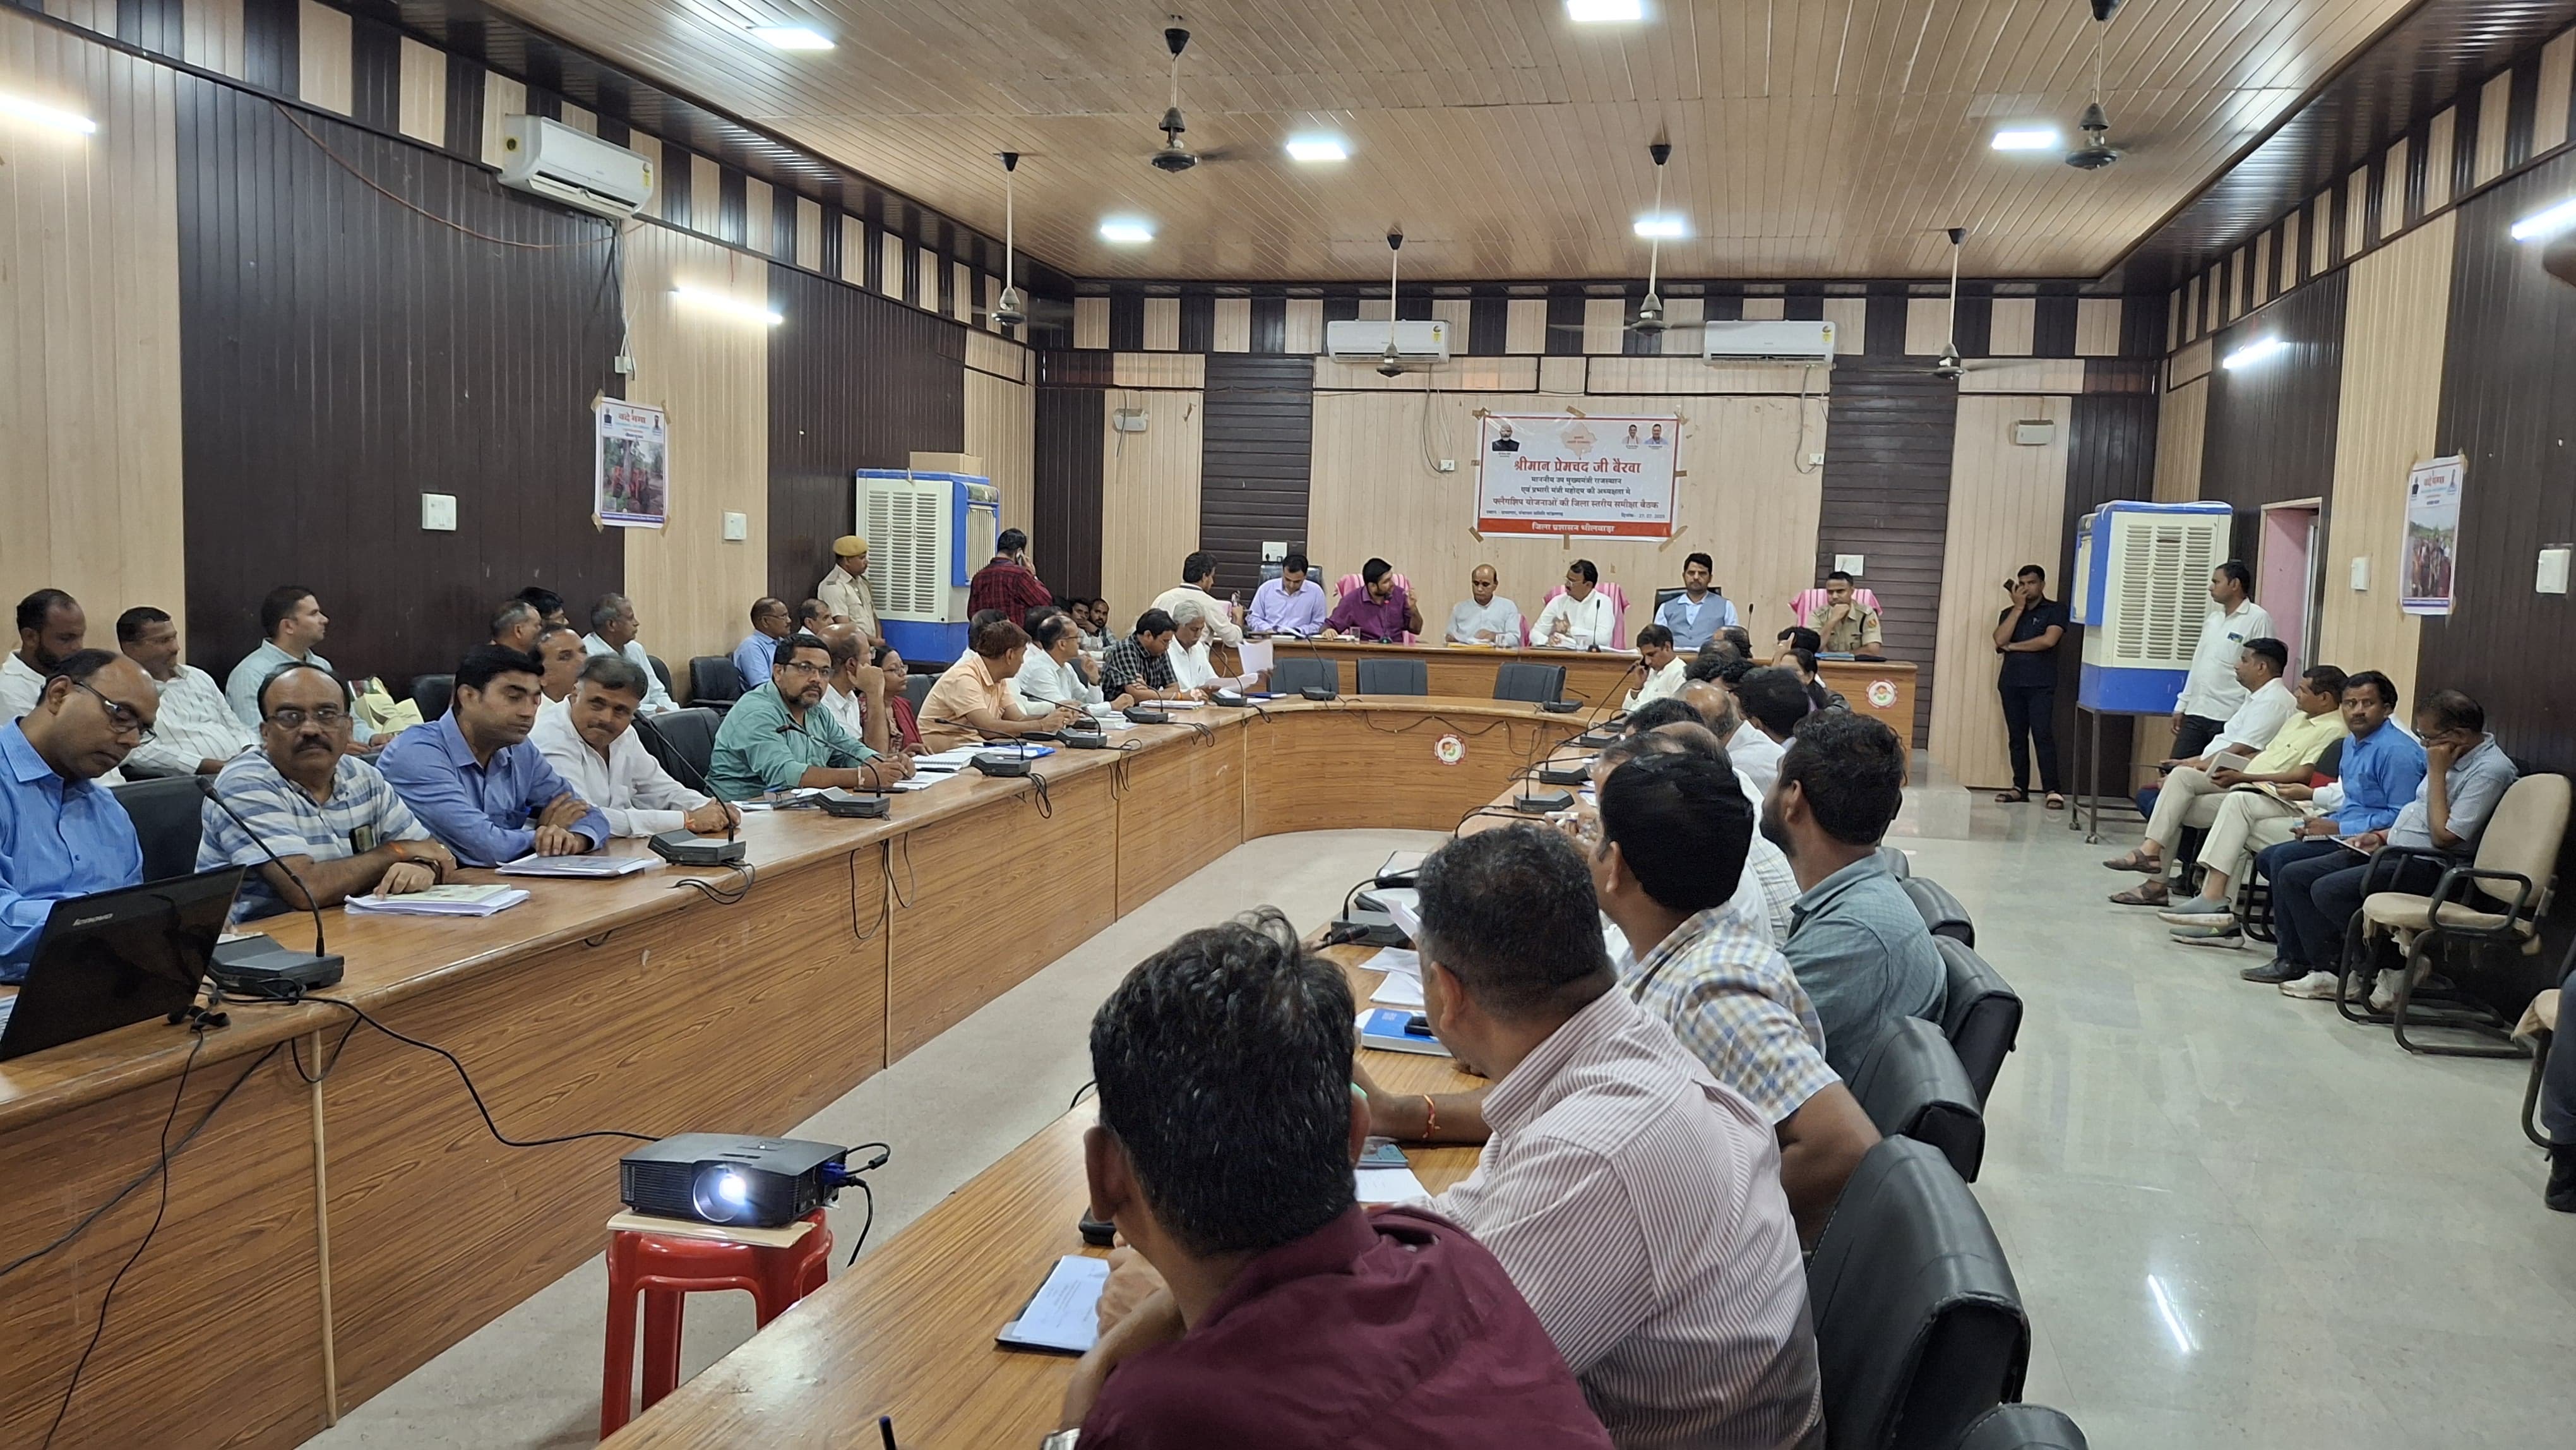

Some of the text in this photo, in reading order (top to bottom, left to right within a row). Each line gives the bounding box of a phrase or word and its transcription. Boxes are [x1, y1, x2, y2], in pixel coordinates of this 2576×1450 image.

[1514, 455, 1642, 474] श्रीमान प्रेमचंद जी बैरवा
[1531, 475, 1554, 483] माननीय
[1587, 486, 1595, 494] की
[1493, 496, 1659, 509] फ्लैगशिप योजनाओं की जिला स्तरीय समीक्षा बैठक
[1532, 520, 1615, 534] जिला प्रशासन भीलवाड़ा
